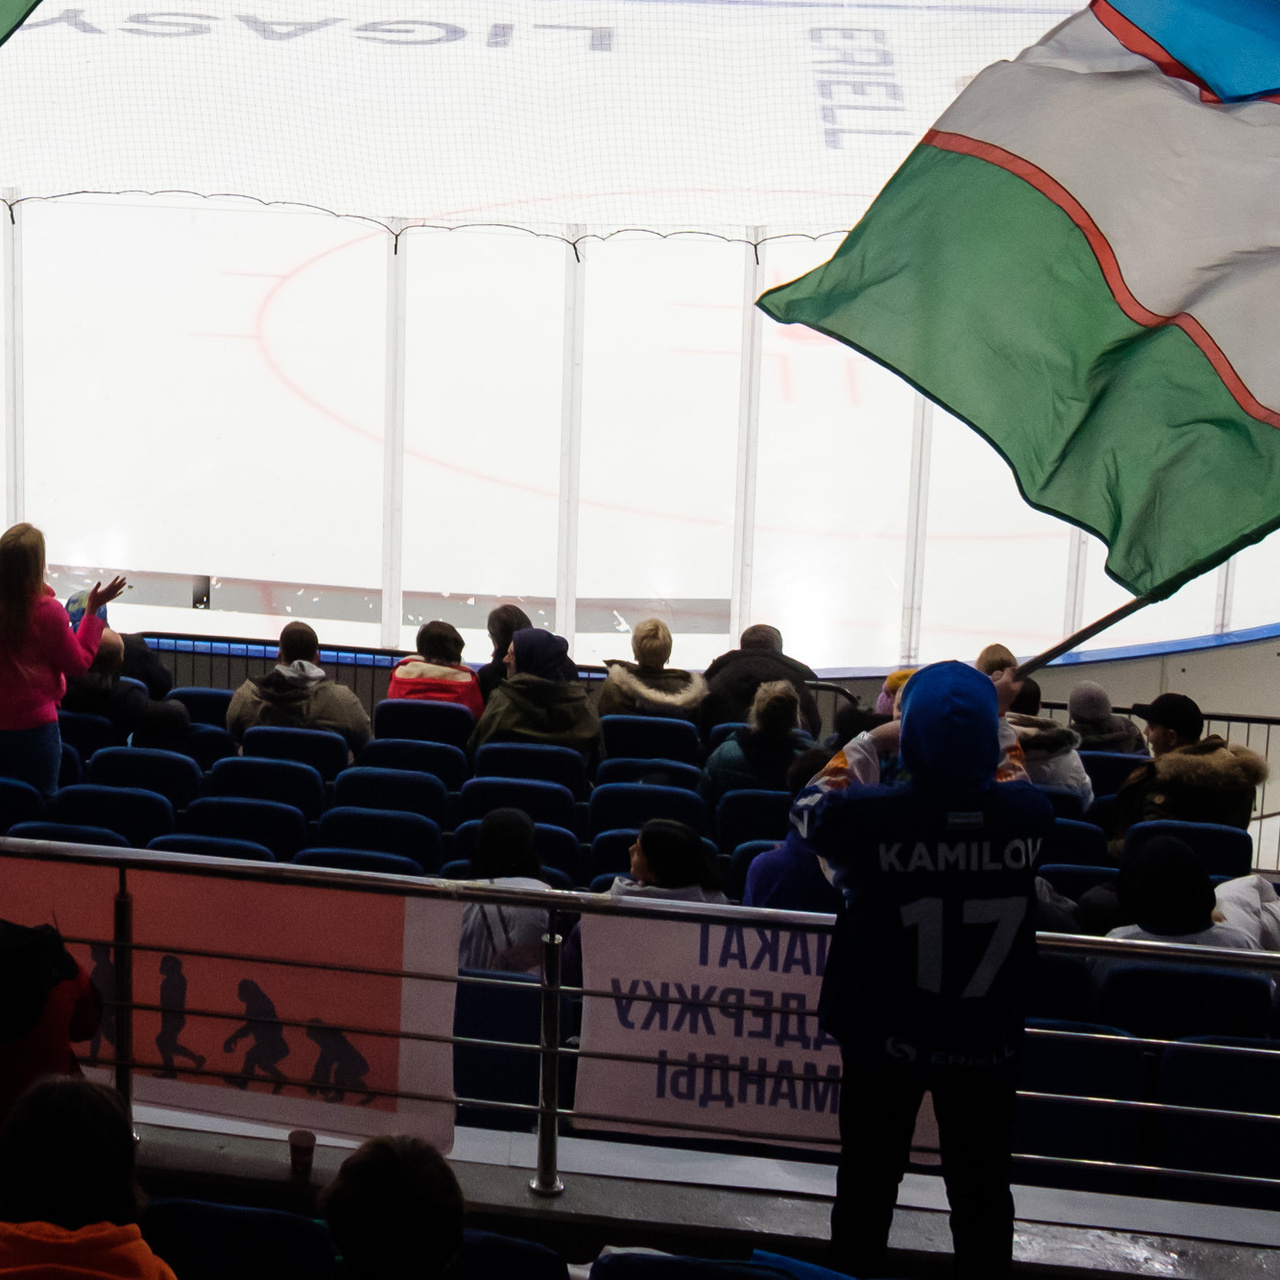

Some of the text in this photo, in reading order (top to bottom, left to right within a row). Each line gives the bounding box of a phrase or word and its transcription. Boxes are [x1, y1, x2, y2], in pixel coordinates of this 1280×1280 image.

[20, 9, 615, 52] LIGASY
[878, 837, 1044, 874] KAMILOV
[898, 895, 1029, 1000] 17
